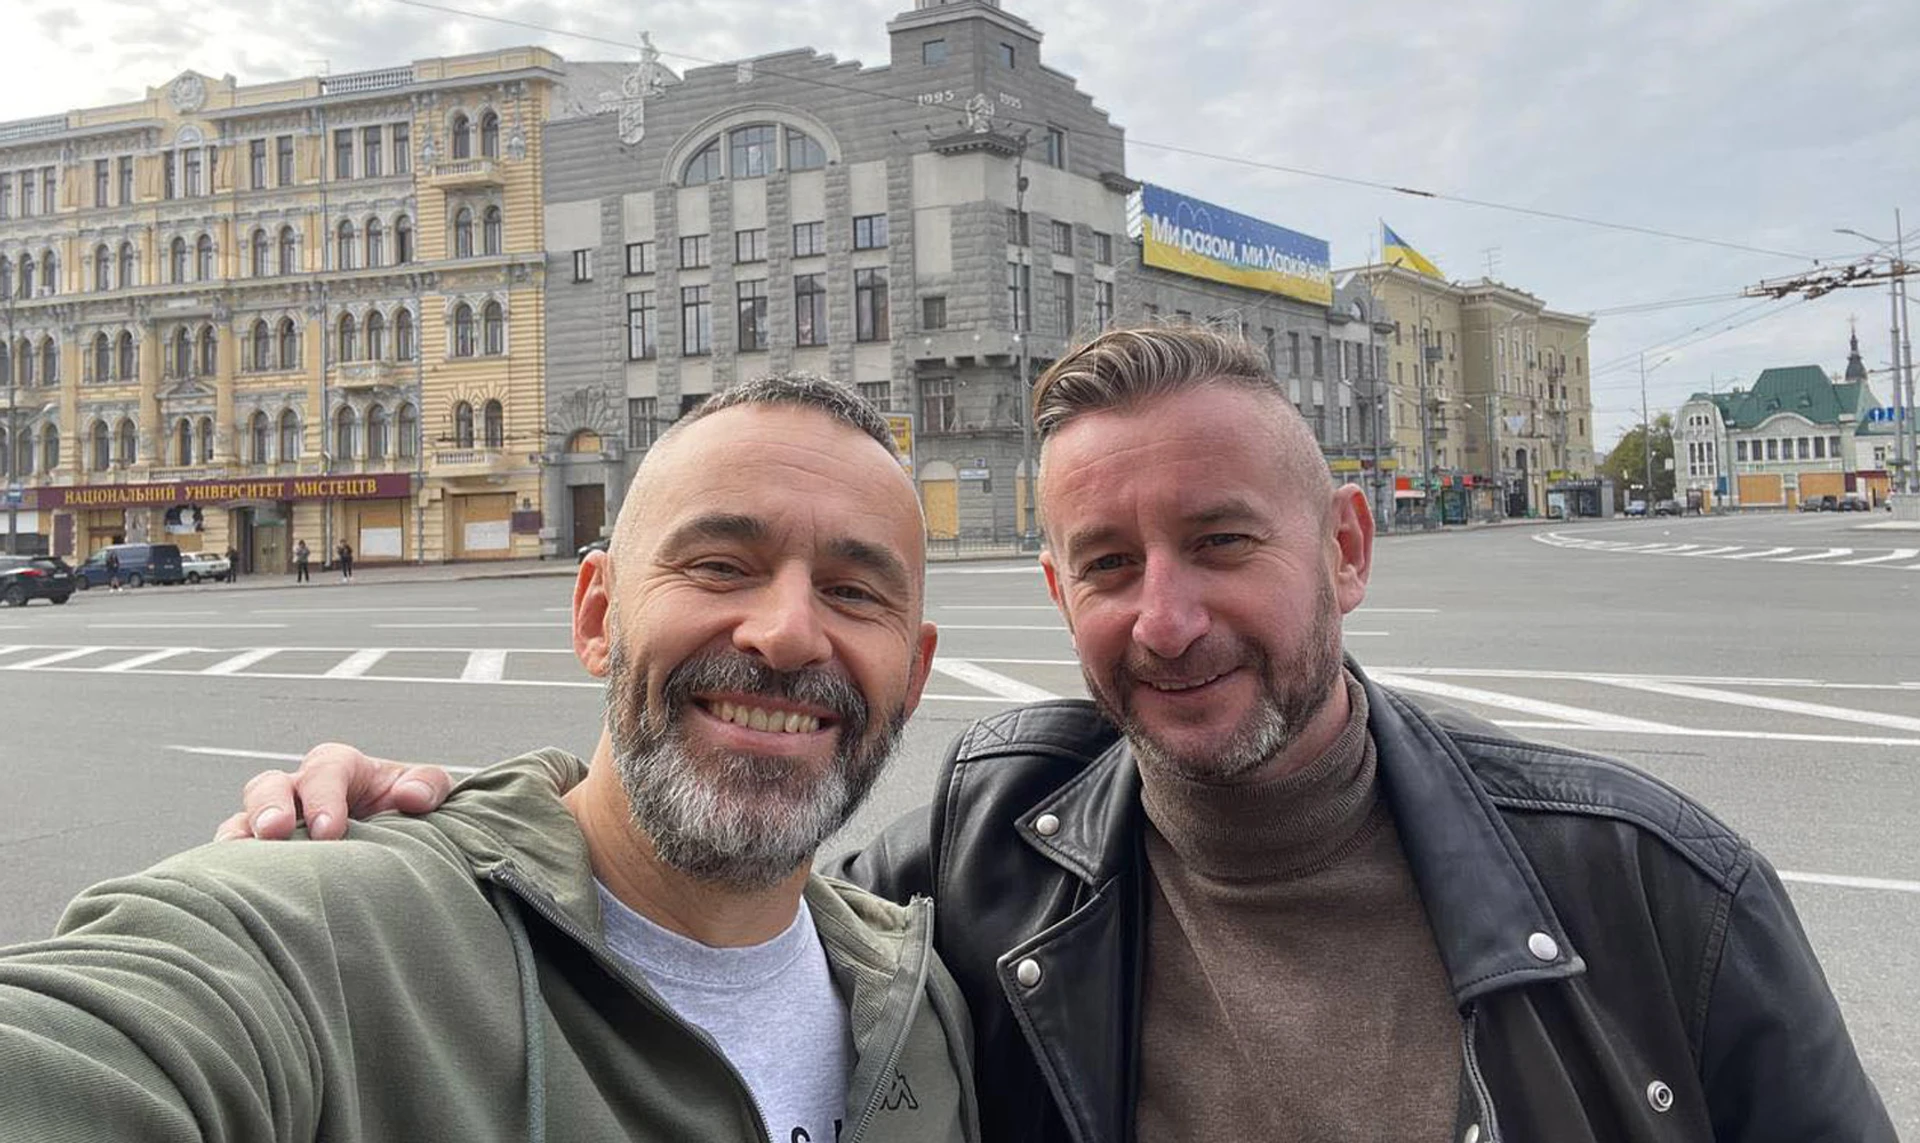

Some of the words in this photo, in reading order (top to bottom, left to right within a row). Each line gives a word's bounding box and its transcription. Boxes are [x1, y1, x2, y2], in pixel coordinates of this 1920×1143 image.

[1152, 213, 1180, 247] Ми
[1182, 228, 1238, 264] разом,
[1242, 243, 1264, 267] ми
[64, 484, 177, 504] НАЦІОНАЛЬНИЙ
[184, 481, 285, 500] УНІВЕРСИТЕТ
[293, 478, 378, 497] МИСТЕЦТВ
